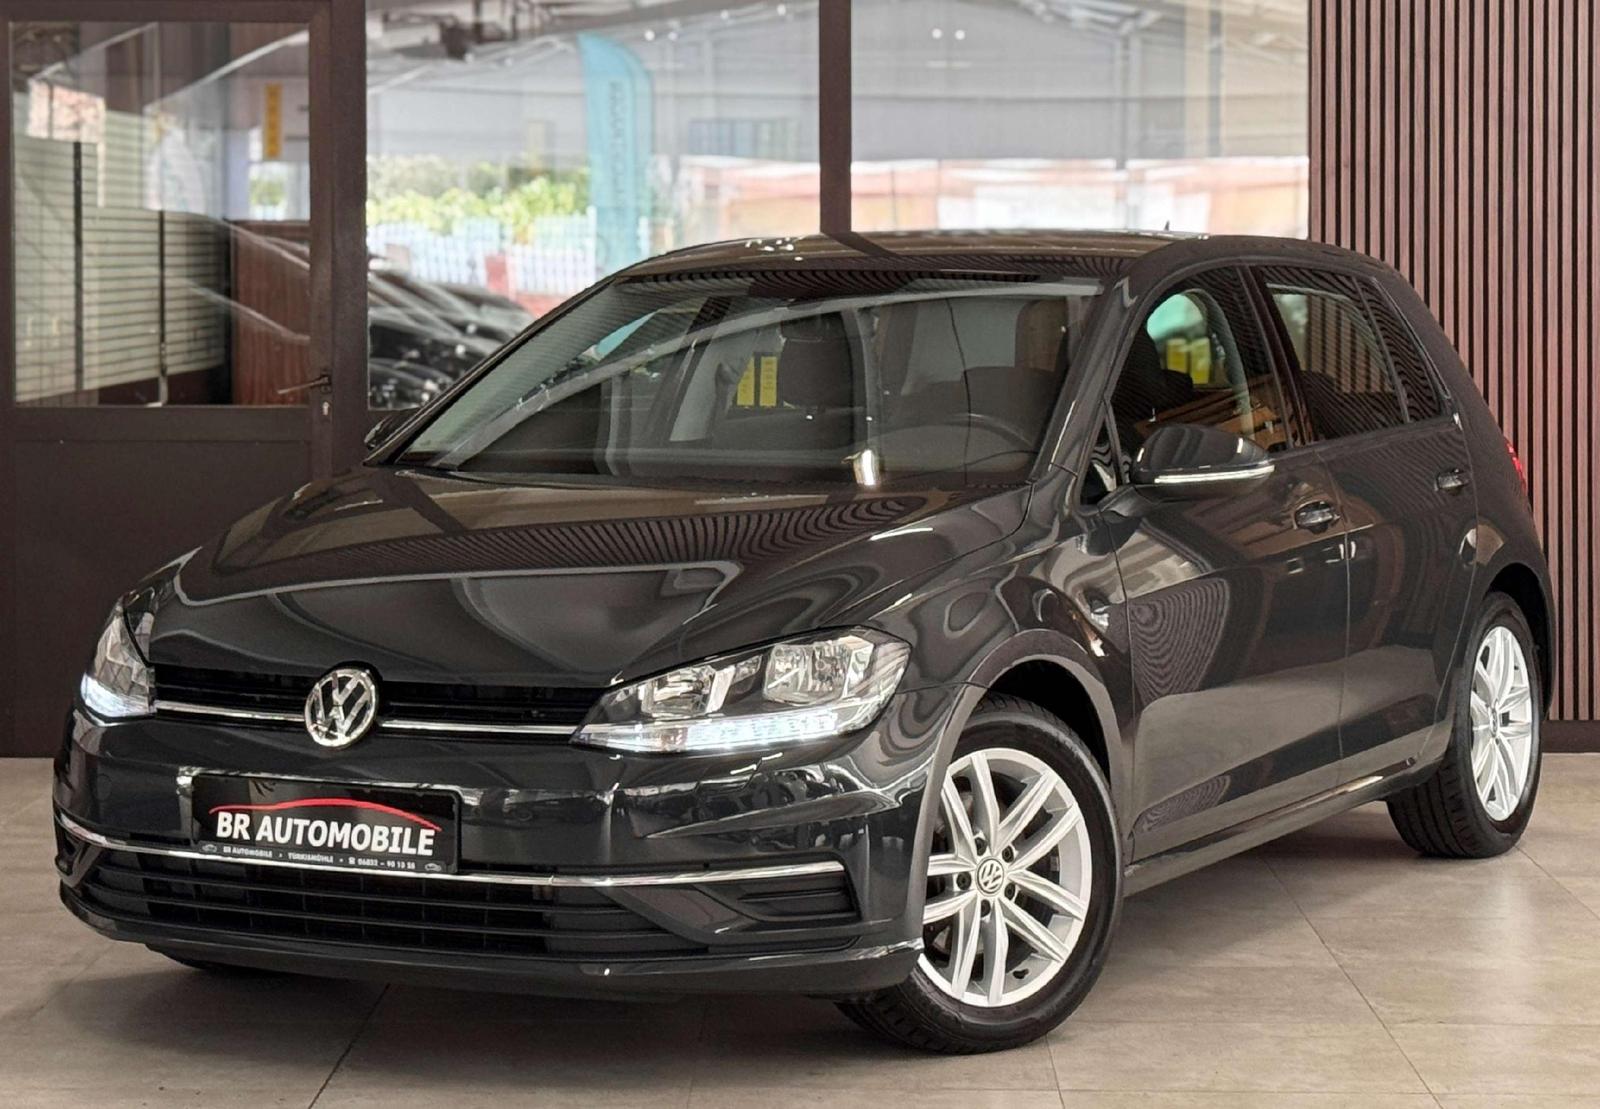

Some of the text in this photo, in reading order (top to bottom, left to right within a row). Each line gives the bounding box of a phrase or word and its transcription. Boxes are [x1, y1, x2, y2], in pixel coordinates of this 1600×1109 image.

[305, 668, 375, 747] VW
[216, 811, 435, 856] BR AUTOMOBILE
[232, 847, 273, 858] AUTOMOBILE
[977, 858, 1004, 894] VW
